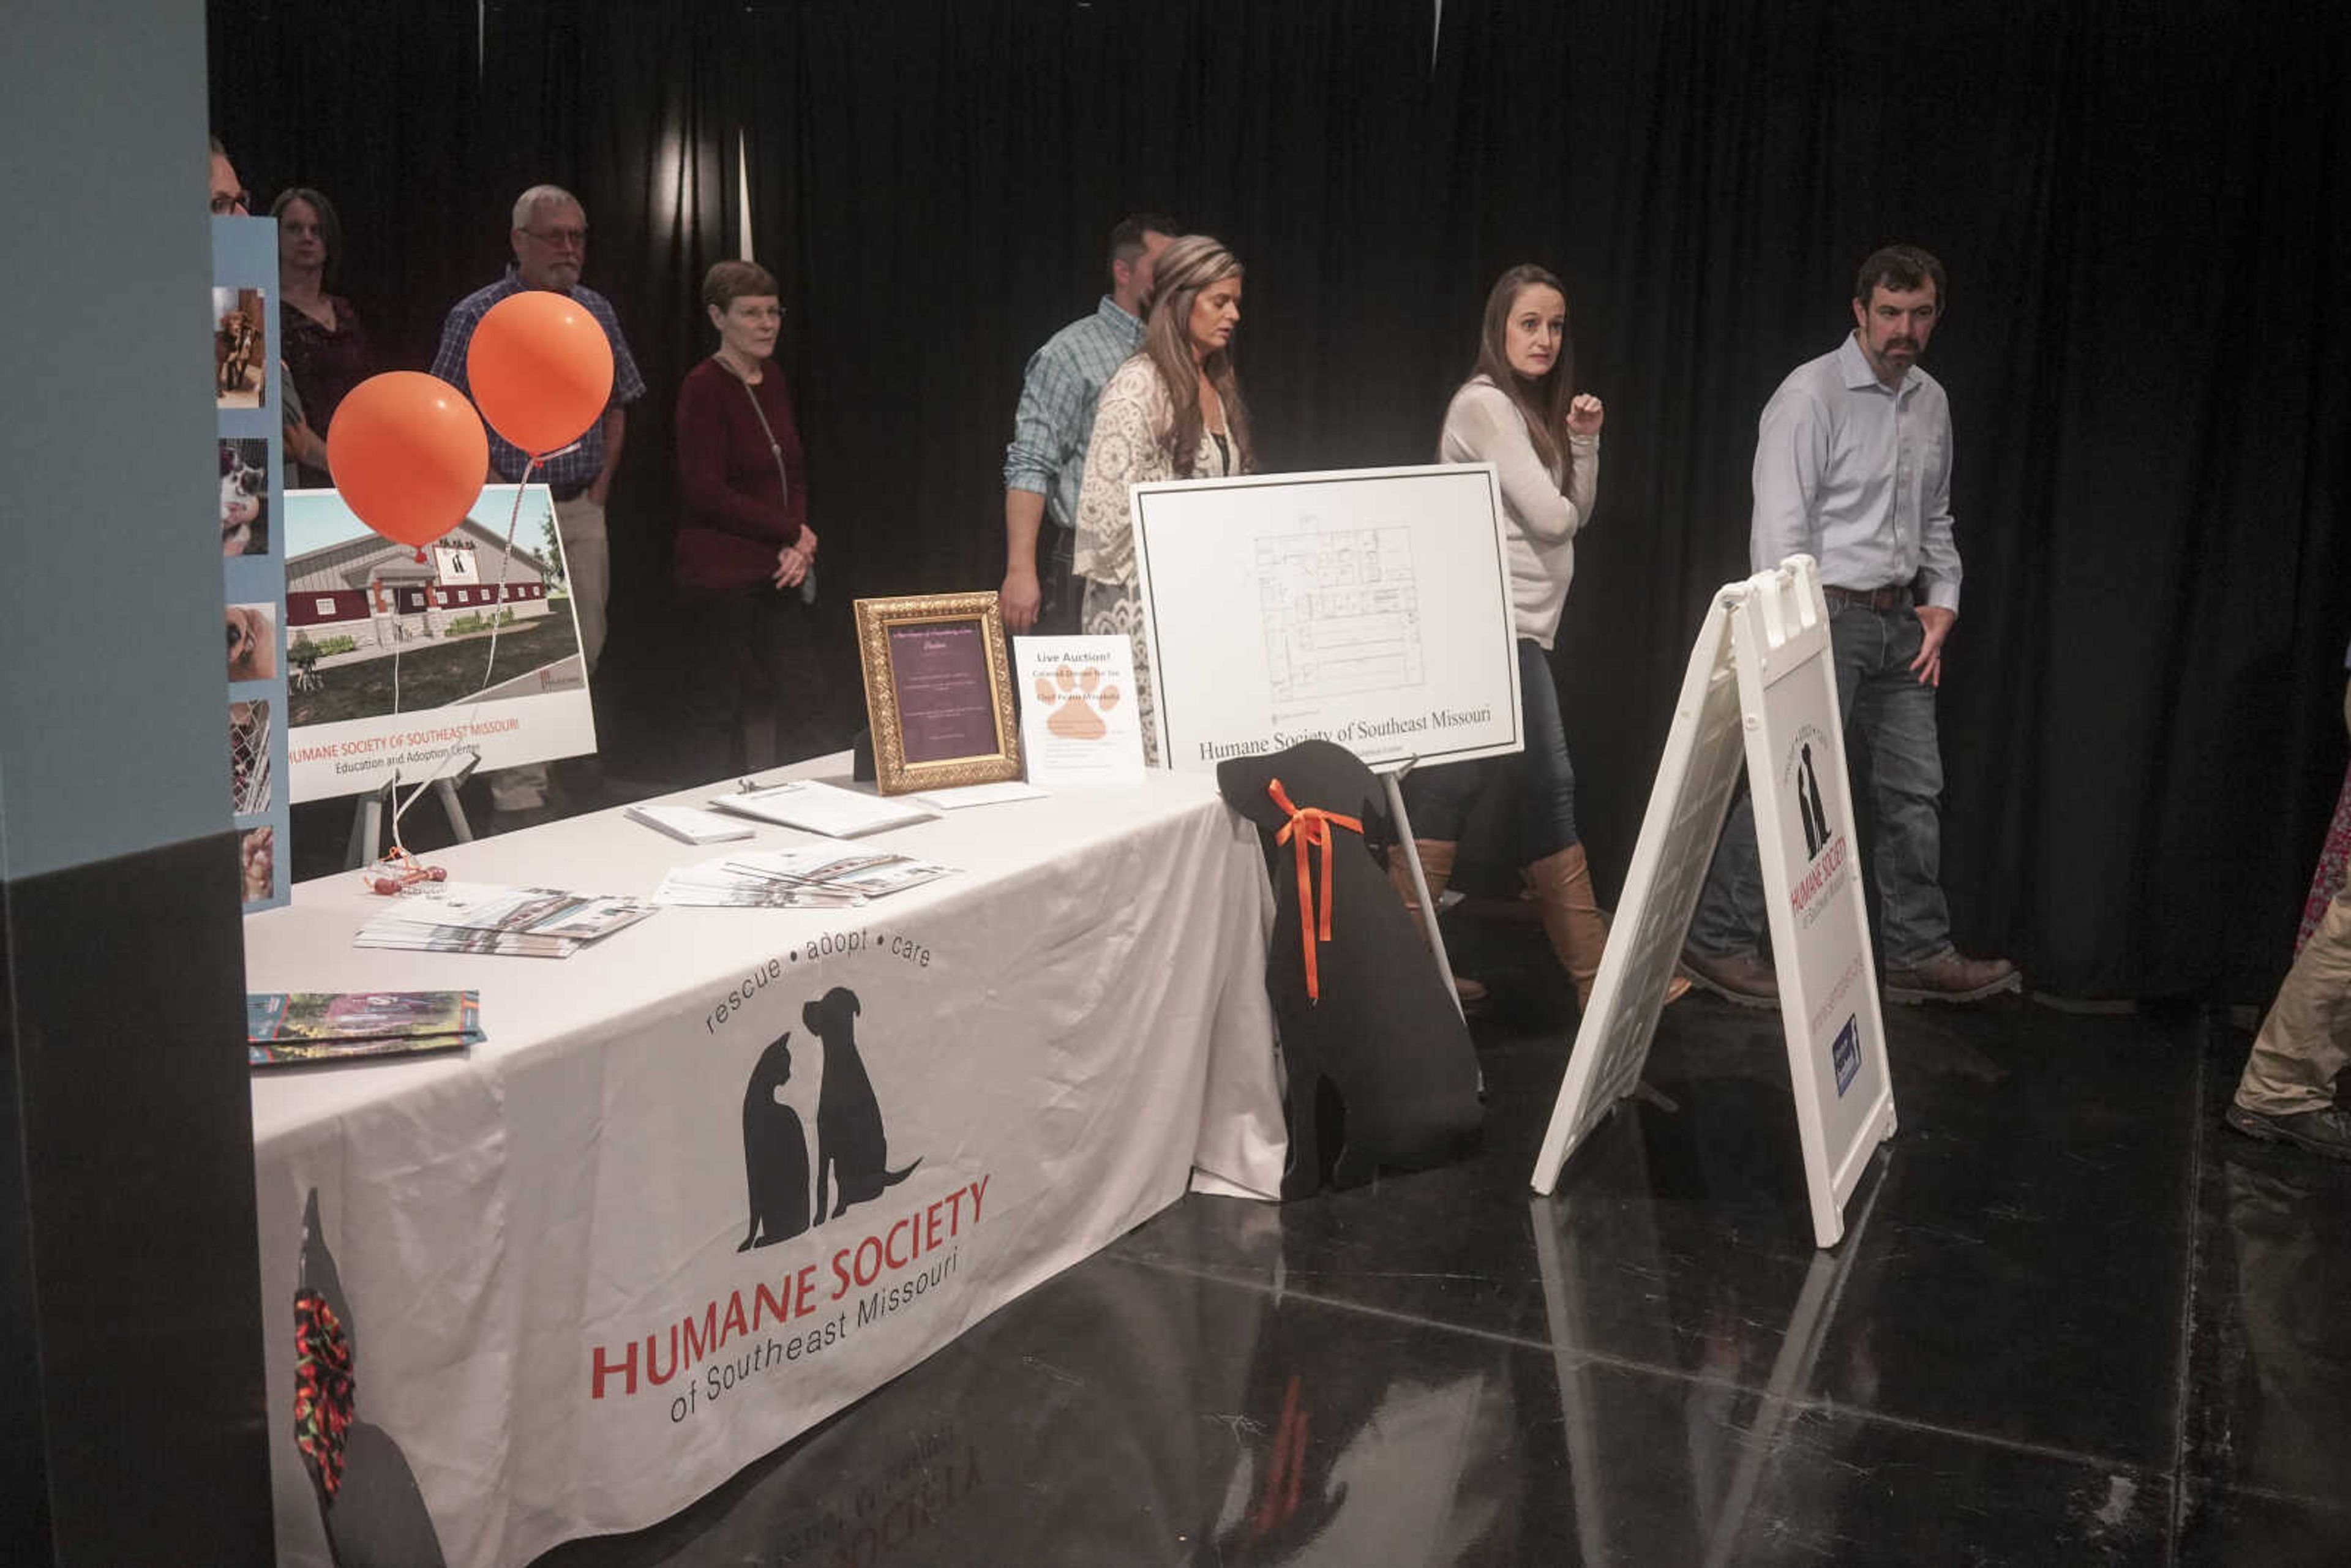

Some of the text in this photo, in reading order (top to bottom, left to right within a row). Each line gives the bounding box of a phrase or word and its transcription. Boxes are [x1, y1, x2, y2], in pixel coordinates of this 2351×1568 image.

[1037, 653, 1059, 662] Live
[341, 737, 387, 756] SOCIETY
[389, 737, 403, 748] OF
[407, 726, 468, 746] SOUTHEAST
[470, 718, 519, 734] MISSOURI
[1199, 737, 1269, 760] Humane
[1338, 721, 1357, 742] of
[1357, 715, 1427, 740] Southeast
[1431, 707, 1491, 730] Missouri
[336, 757, 384, 774] Education
[387, 753, 403, 765] and
[407, 747, 448, 763] Adoption
[705, 929, 931, 1035] rescue adopt care
[591, 1174, 991, 1398] HUMANE SOCIETY
[670, 1245, 959, 1423] of Southeast Missouri
